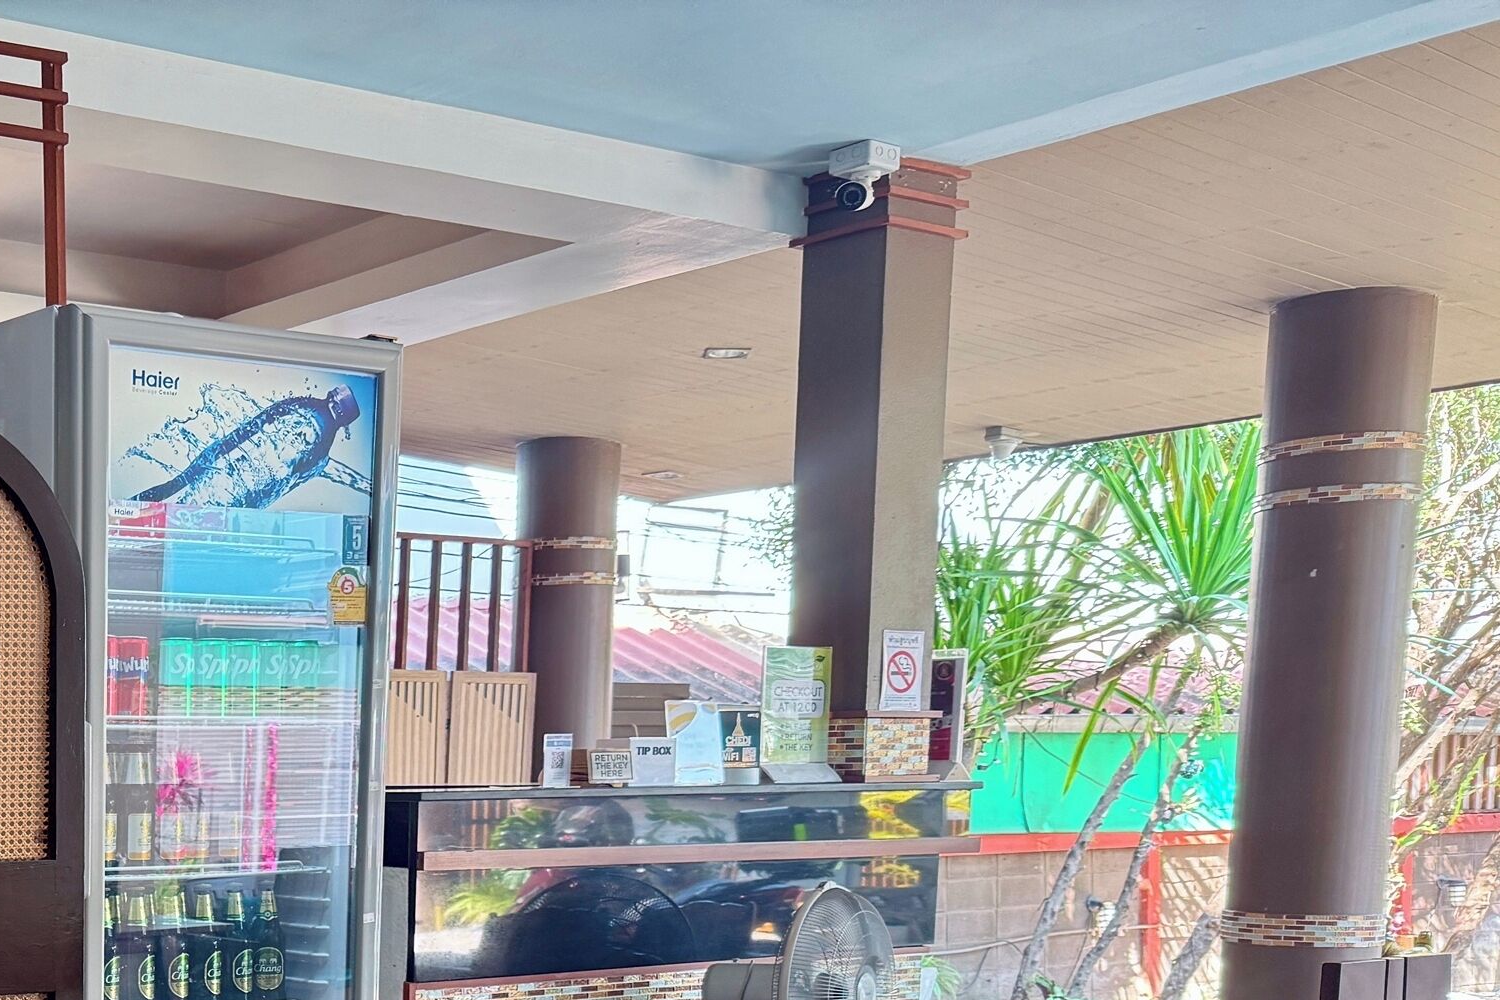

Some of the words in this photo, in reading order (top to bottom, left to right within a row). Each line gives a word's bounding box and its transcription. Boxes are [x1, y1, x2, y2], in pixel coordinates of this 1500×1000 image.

[132, 369, 180, 390] Haier
[114, 508, 134, 516] Haier
[352, 525, 362, 550] 5
[778, 702, 790, 713] AT
[784, 733, 812, 741] RETURN
[636, 746, 651, 755] TIP
[652, 746, 672, 755] BOX
[784, 743, 799, 751] THE
[800, 743, 813, 751] KEY
[594, 754, 628, 762] RETURN
[595, 762, 612, 770] THE
[254, 963, 282, 973] Chang
